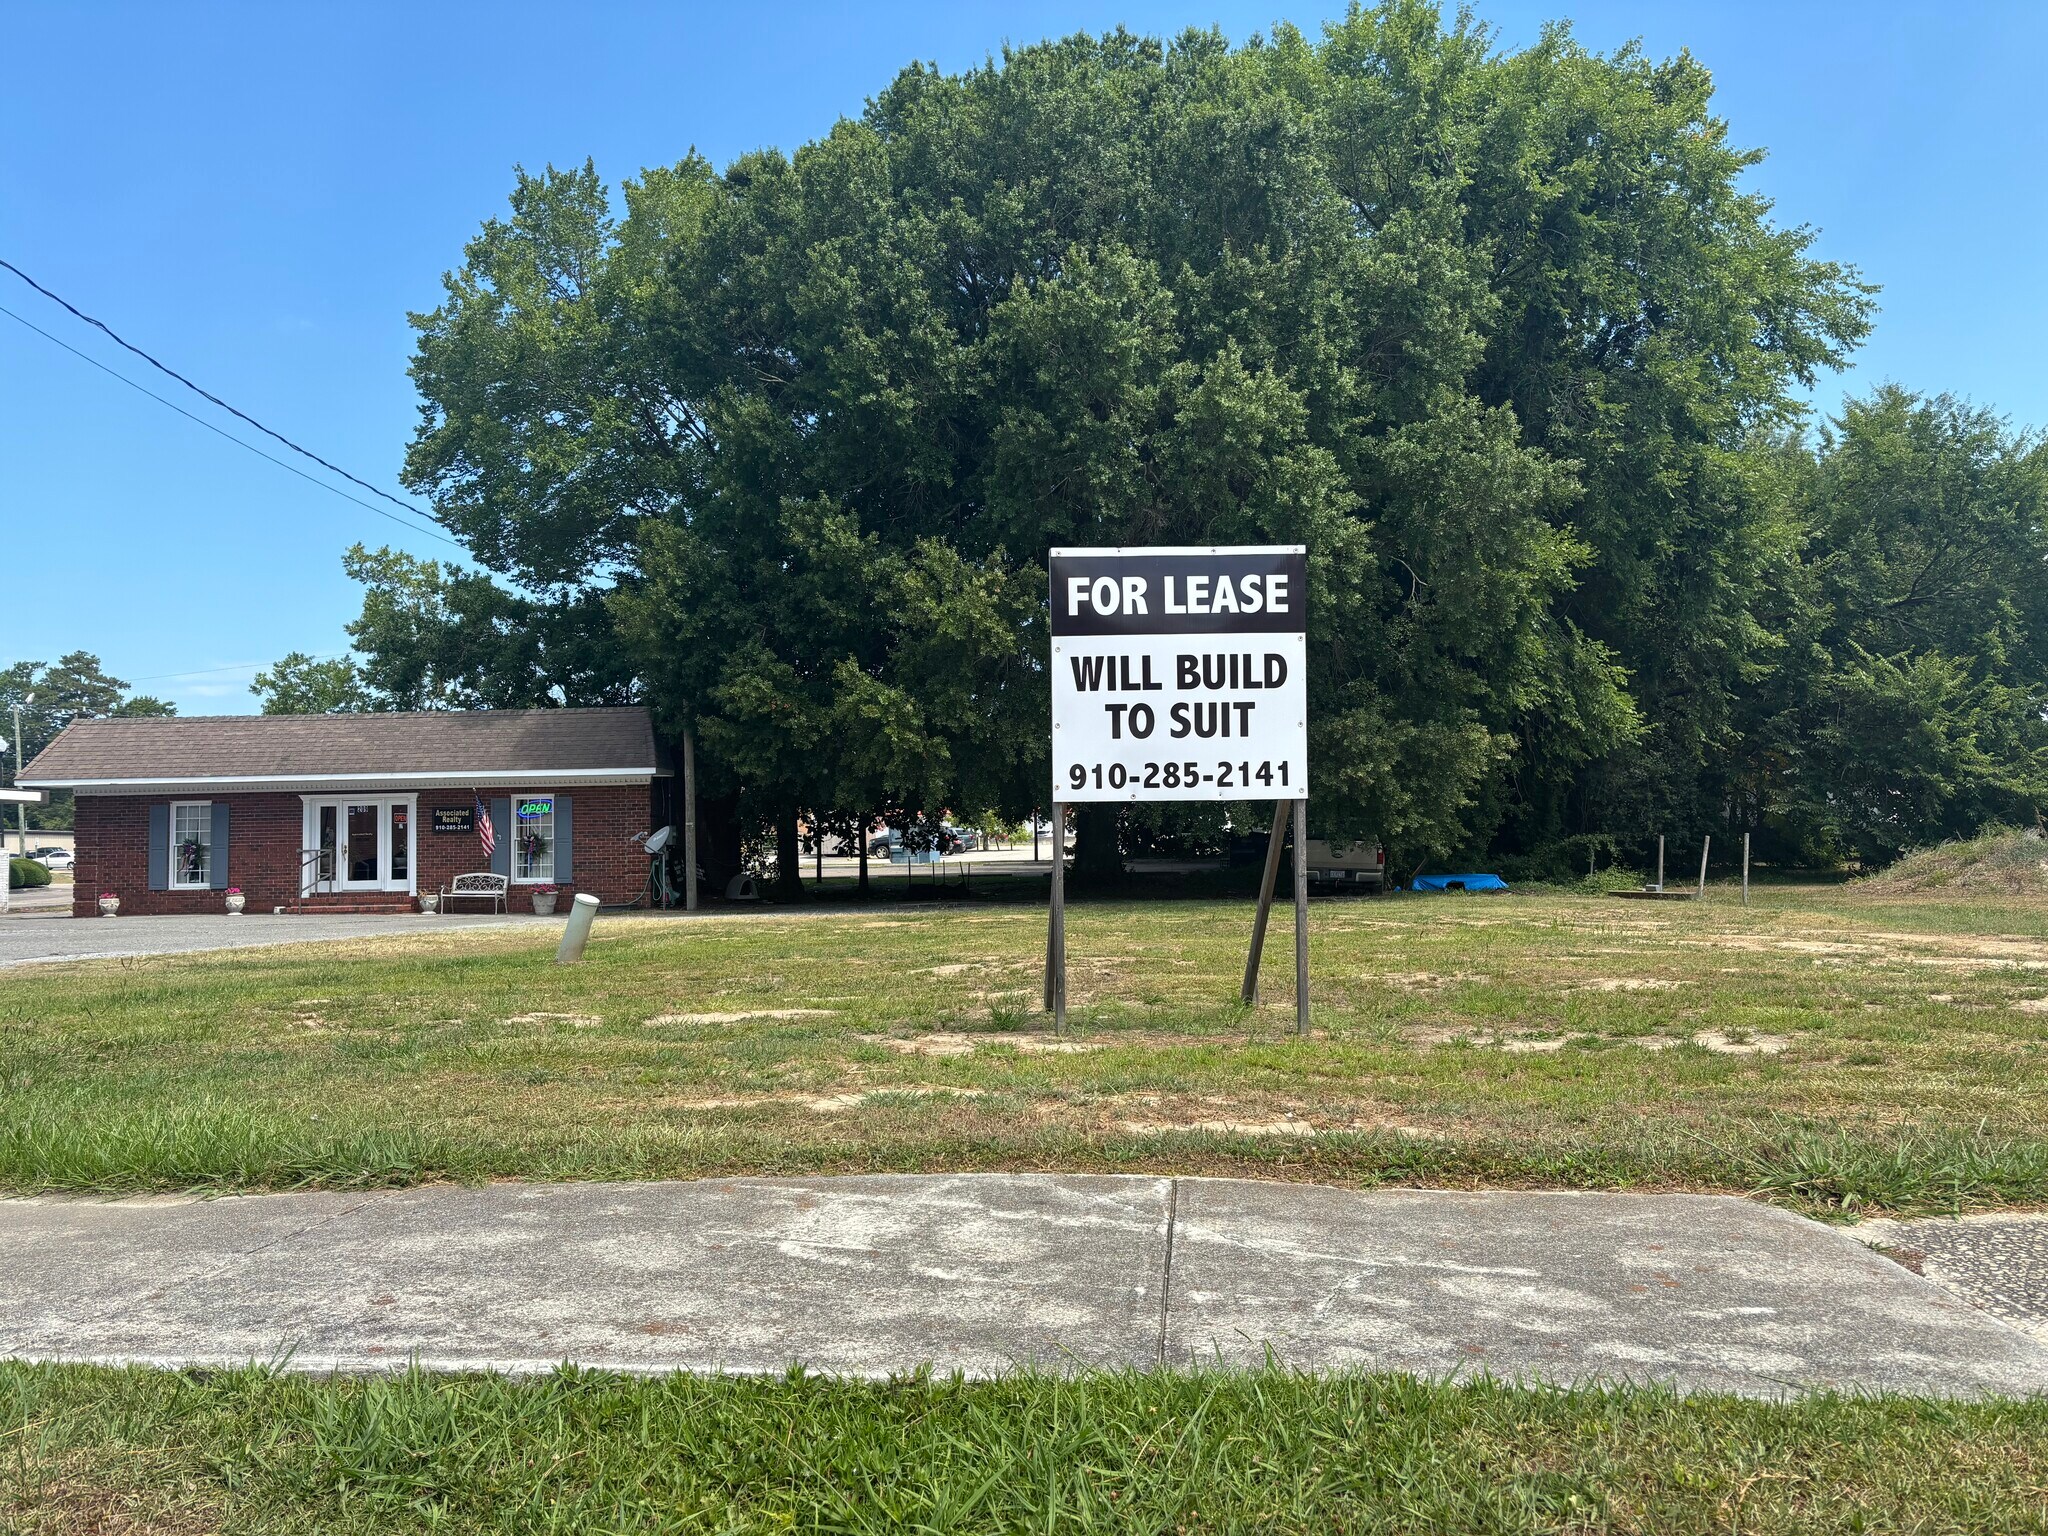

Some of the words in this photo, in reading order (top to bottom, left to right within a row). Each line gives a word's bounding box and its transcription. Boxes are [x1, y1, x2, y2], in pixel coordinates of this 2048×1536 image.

[1067, 576, 1149, 616] FOR
[1164, 574, 1289, 614] LEASE
[1070, 655, 1163, 692] WILL
[1176, 653, 1288, 690] BUILD
[1104, 702, 1155, 739] TO
[1170, 701, 1255, 738] SUIT
[1069, 760, 1289, 790] 910-285-2141
[435, 809, 470, 817] Associated
[442, 816, 462, 824] Realty
[521, 803, 550, 815] OPEN
